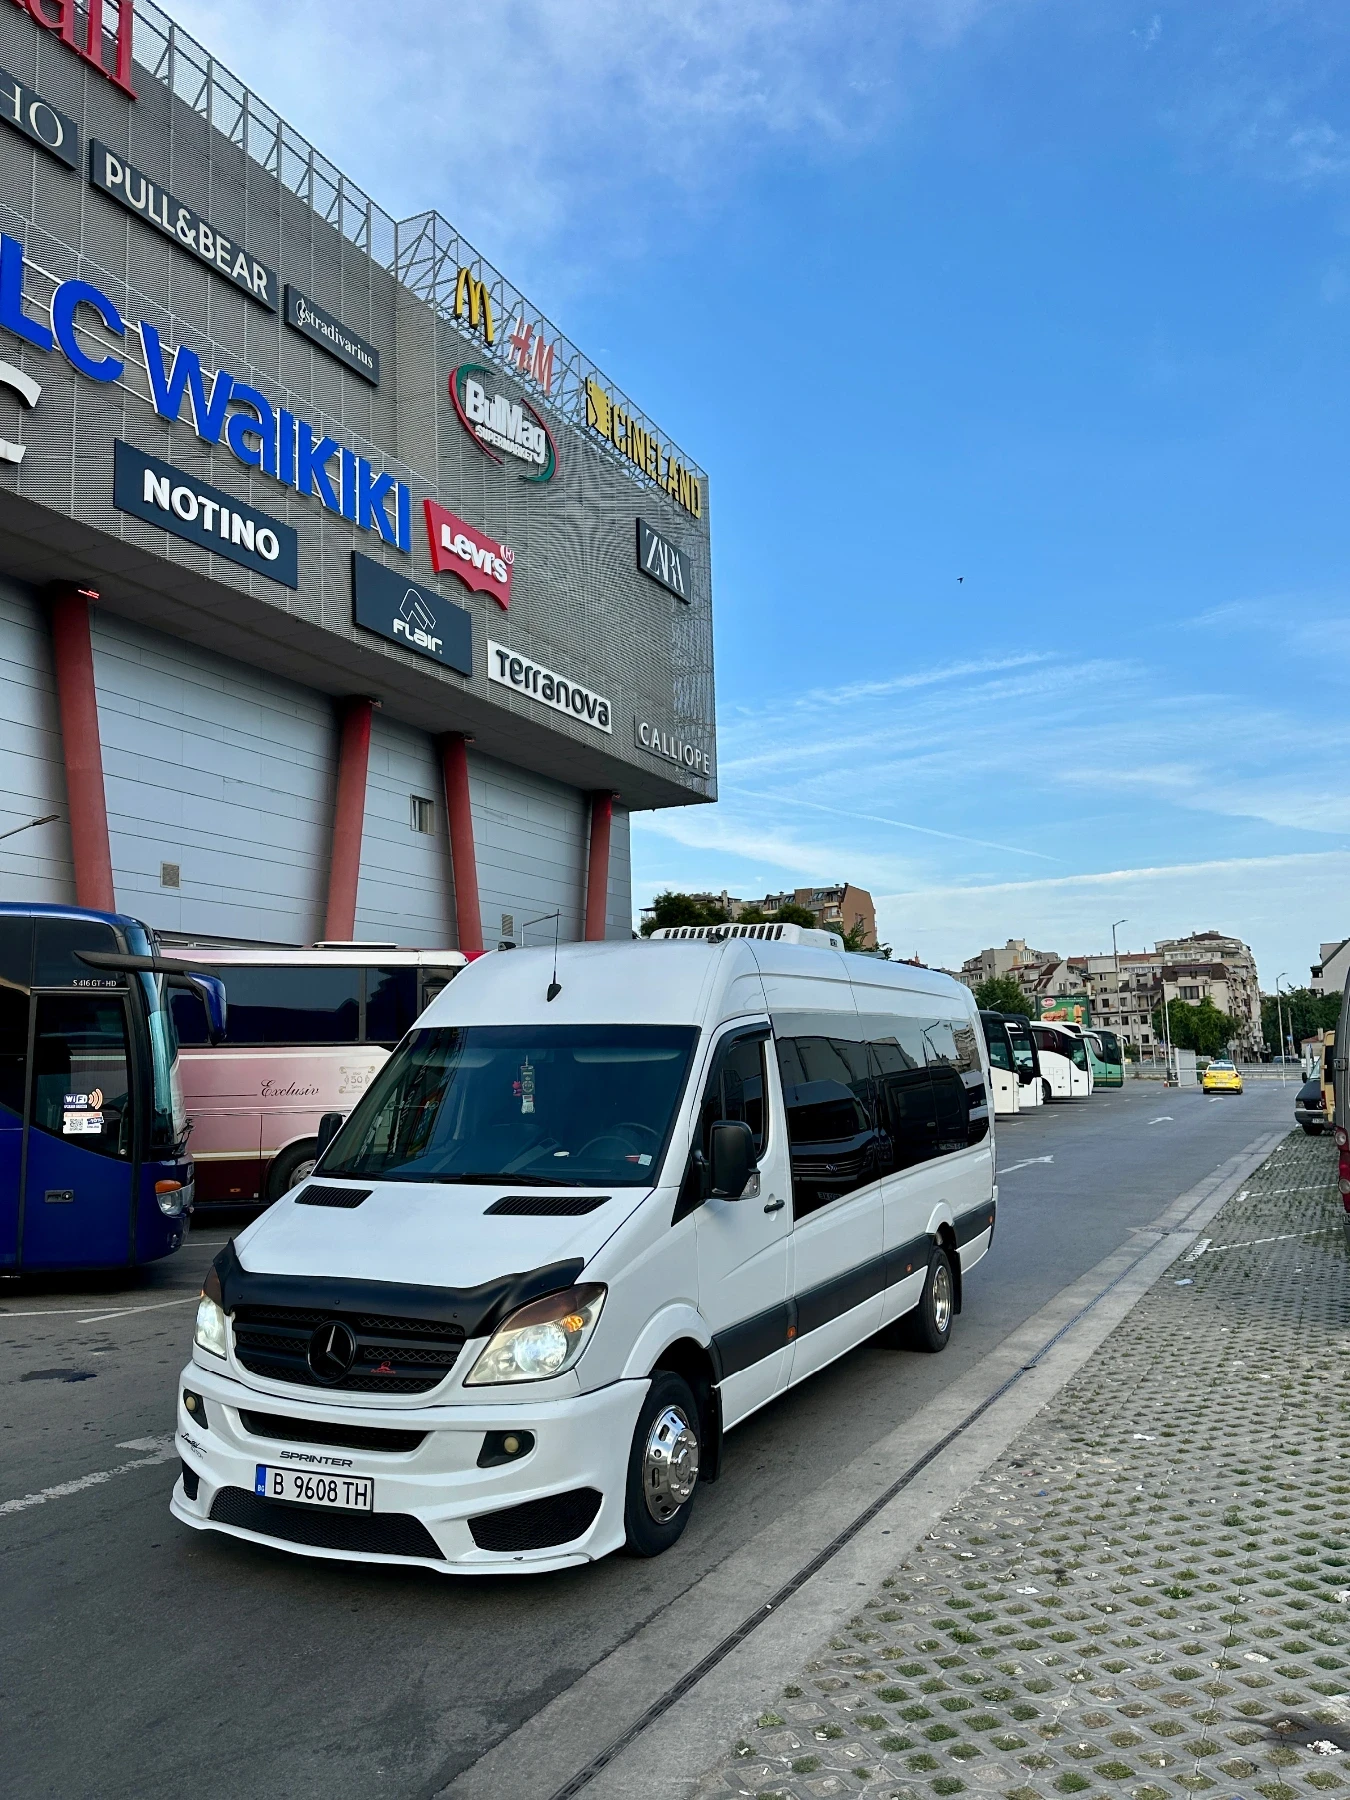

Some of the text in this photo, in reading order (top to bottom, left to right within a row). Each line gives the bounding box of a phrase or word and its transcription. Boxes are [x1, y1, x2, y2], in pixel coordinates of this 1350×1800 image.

[105, 152, 269, 301] PULL&BEAR
[0, 231, 125, 384] LC
[475, 424, 533, 462] SUPERMARKET
[610, 403, 701, 520] CINELAND
[144, 469, 281, 561] NOTINO
[645, 528, 686, 595] ZARA
[495, 649, 610, 727] Terranova
[638, 722, 710, 775] CALLIOPE
[72, 979, 78, 987] S
[78, 979, 91, 987] 416
[260, 1079, 320, 1098] Exclusiv
[279, 1450, 354, 1468] SPRINTER
[273, 1472, 368, 1507] B 9608 TH
